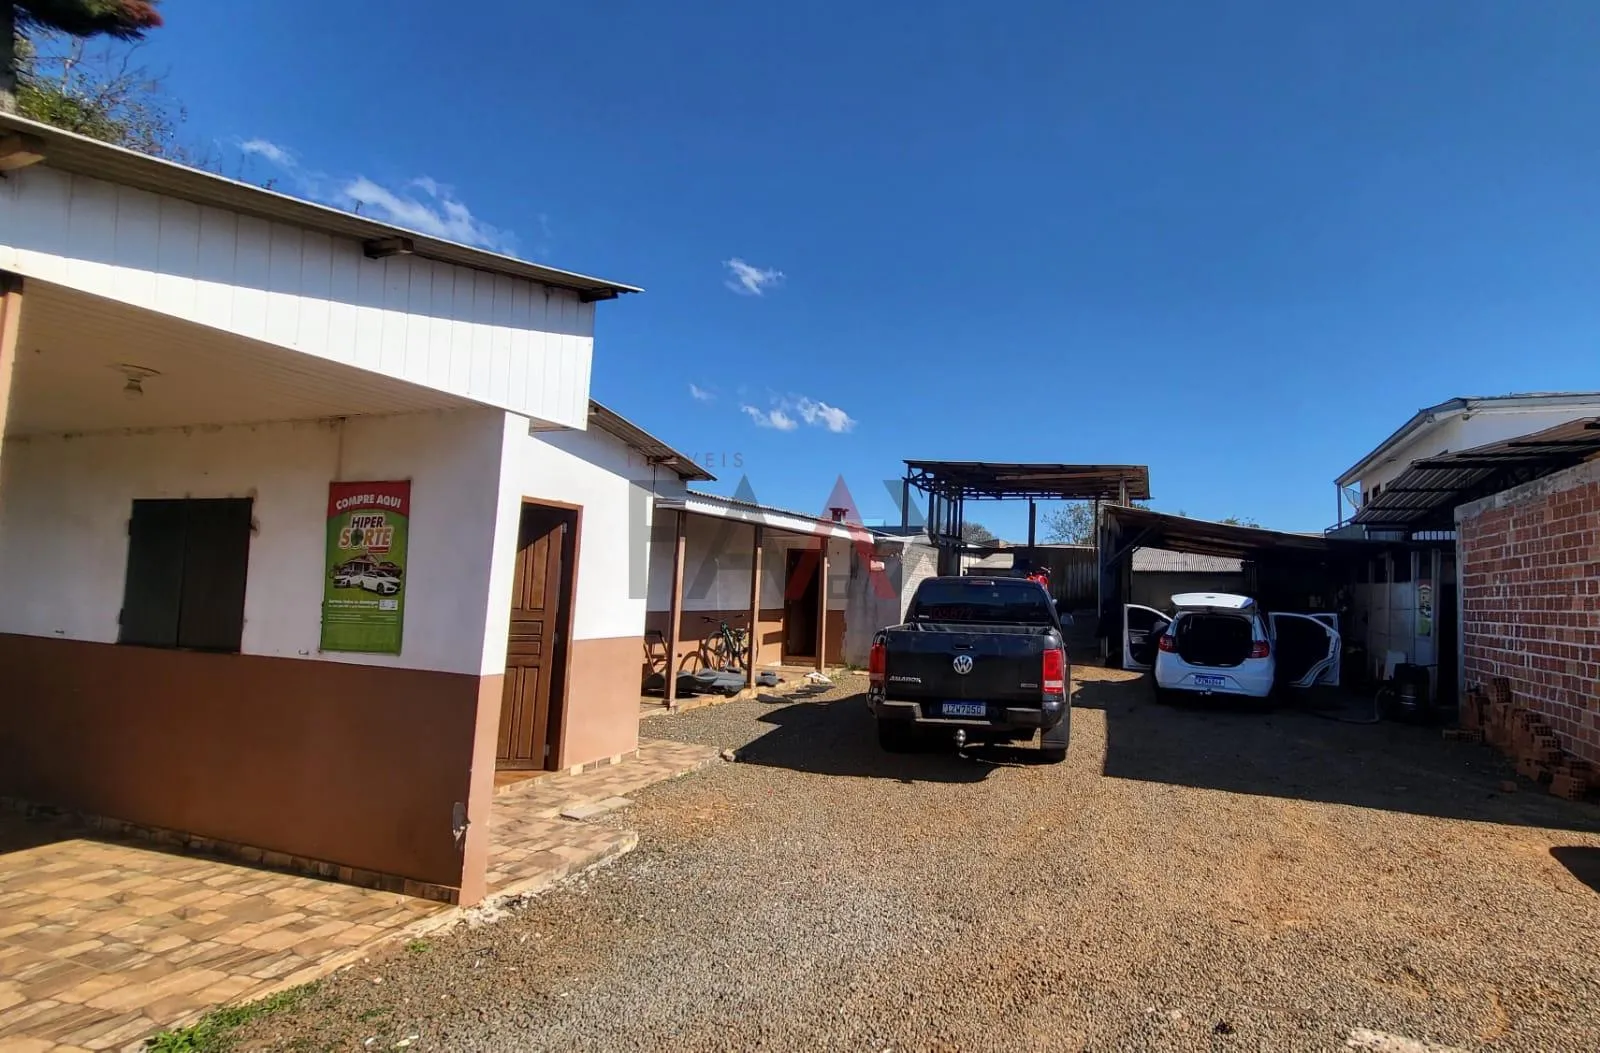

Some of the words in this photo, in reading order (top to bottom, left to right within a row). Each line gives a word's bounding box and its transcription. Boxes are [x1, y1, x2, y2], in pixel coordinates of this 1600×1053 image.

[336, 494, 375, 510] COMPRE
[376, 494, 402, 509] AQUI
[352, 516, 384, 529] HIPER
[340, 527, 392, 547] SORTE
